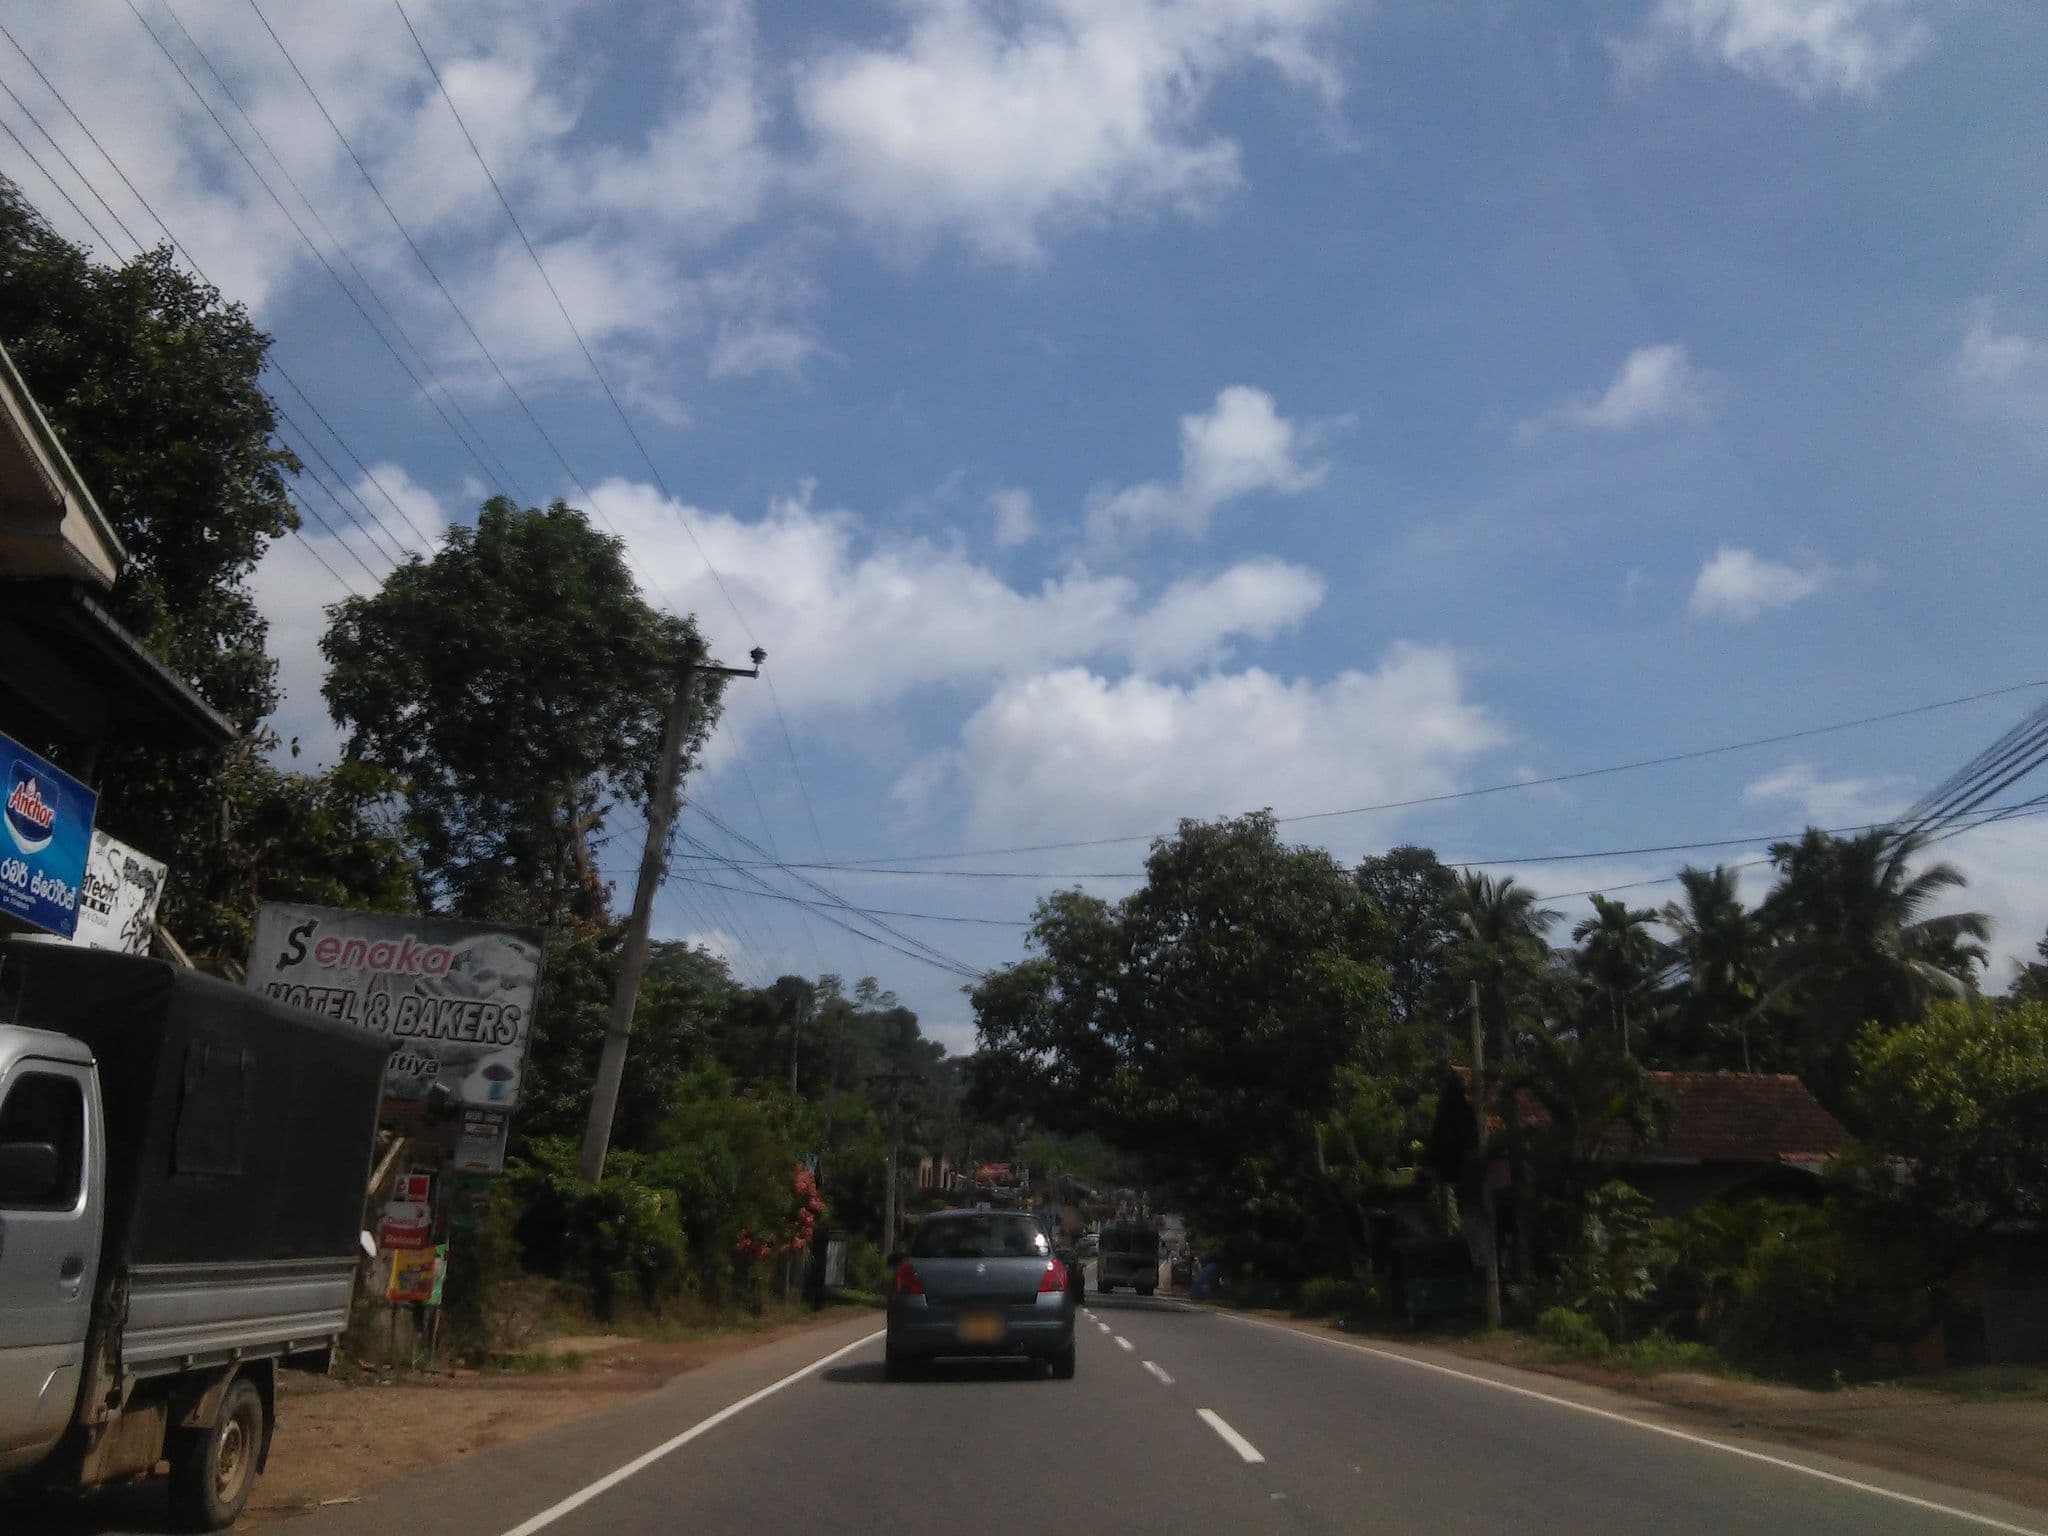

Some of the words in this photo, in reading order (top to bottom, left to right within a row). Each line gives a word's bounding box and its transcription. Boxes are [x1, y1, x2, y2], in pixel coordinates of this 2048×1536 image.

[9, 781, 55, 828] Anchor
[276, 919, 453, 976] Senaka
[365, 992, 391, 1032] &
[394, 995, 521, 1045] BAKERS
[388, 1054, 440, 1076] itiya
